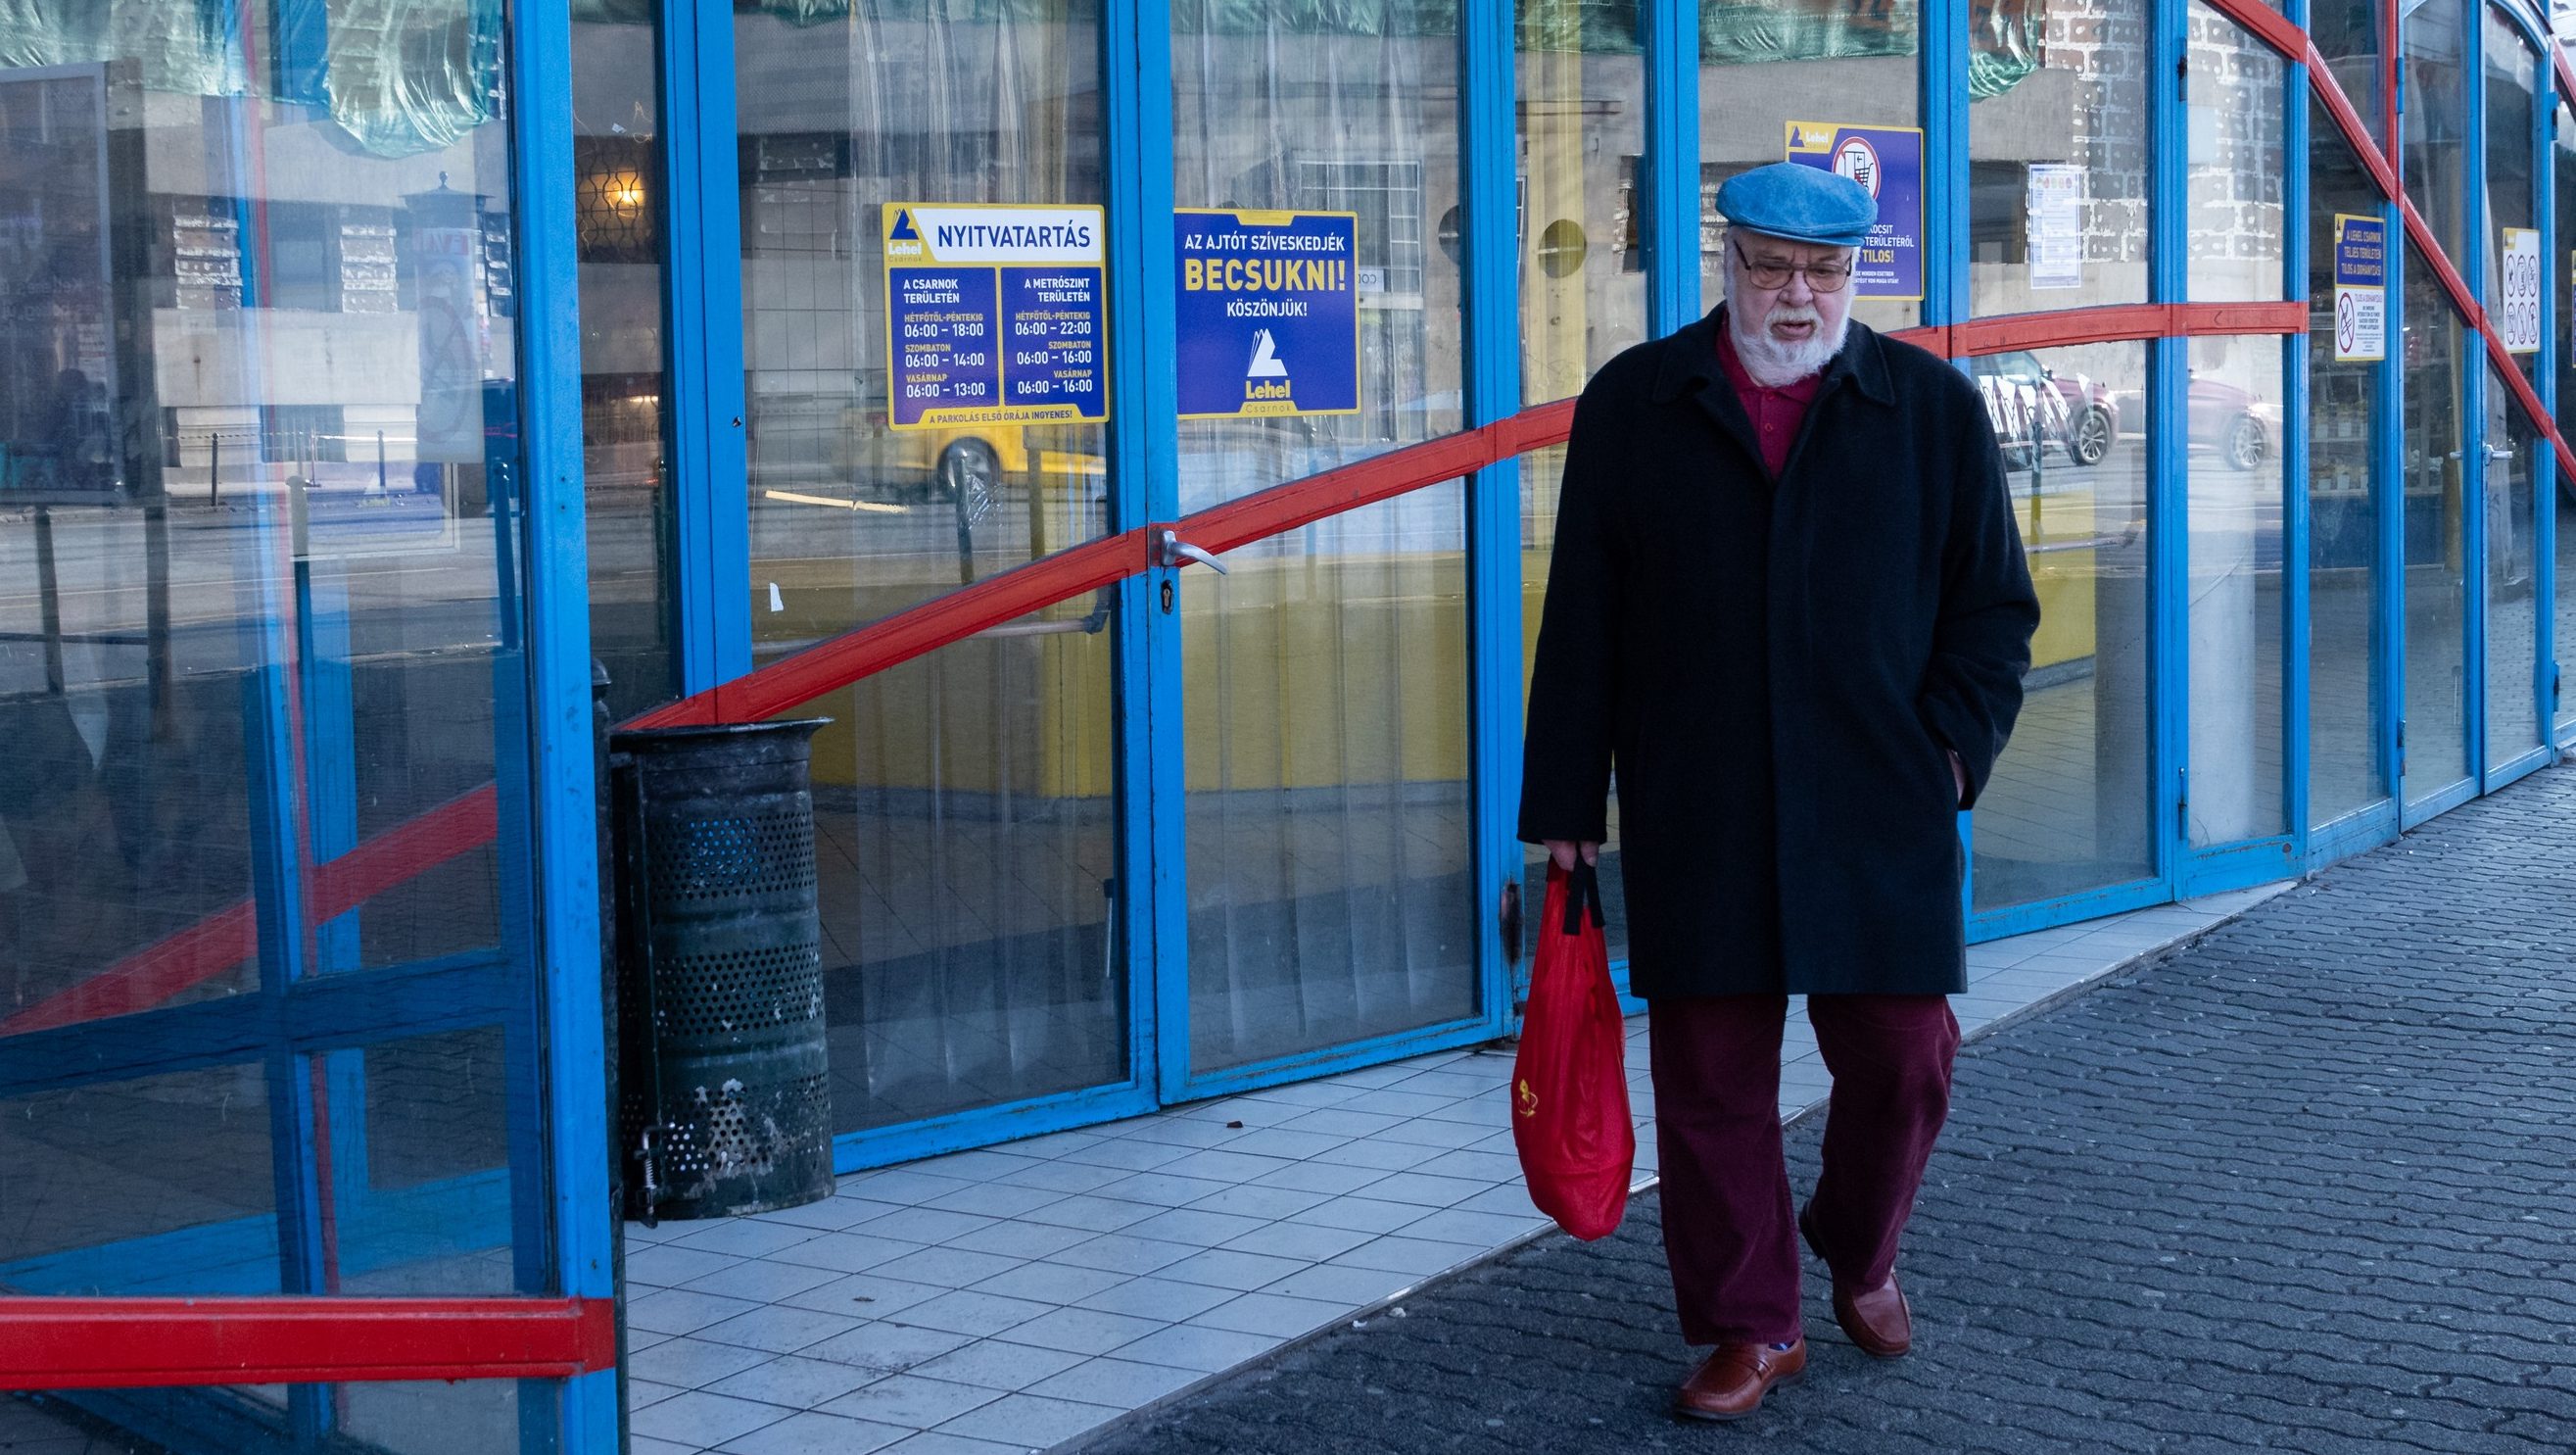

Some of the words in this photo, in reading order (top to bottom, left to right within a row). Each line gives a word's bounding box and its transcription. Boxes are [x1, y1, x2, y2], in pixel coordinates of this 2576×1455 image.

[937, 219, 1090, 248] NYITVATARTÁS
[1184, 234, 1202, 250] AZ
[1206, 231, 1247, 250] AJTÓT
[1251, 231, 1345, 251] SZÍVESKEDJÉK
[888, 242, 922, 256] Lehel
[1863, 250, 1894, 263] TILOS!
[1025, 278, 1031, 288] A
[1032, 275, 1090, 288] METRÓSZINT
[1185, 259, 1345, 291] BECSUKNI!
[903, 279, 911, 289] A
[913, 279, 958, 290] CSARNOK
[903, 290, 960, 304] TERÜLETÉN
[1038, 289, 1090, 302] TERÜLETÉN
[1227, 299, 1308, 316] KÖSZÖNJÜK!
[904, 324, 938, 337] 06:00
[952, 323, 983, 337] 18:00
[1015, 322, 1047, 335] 06:00
[1060, 321, 1091, 335] 22:00
[905, 354, 938, 367] 06:00
[953, 353, 984, 366] 14:00
[1017, 352, 1048, 364] 06:00
[1062, 351, 1092, 364] 16:00
[906, 372, 947, 382] VASÁRNAP
[1054, 369, 1092, 378] VASÁRNAP
[906, 384, 939, 398] 06:00
[954, 382, 985, 396] 13:00
[1018, 381, 1049, 394] 06:00
[1063, 379, 1092, 393] 16:00
[1245, 380, 1291, 399] Lehel
[937, 411, 980, 423] PARKOLÁS
[1031, 411, 1073, 419] INGYENES!
